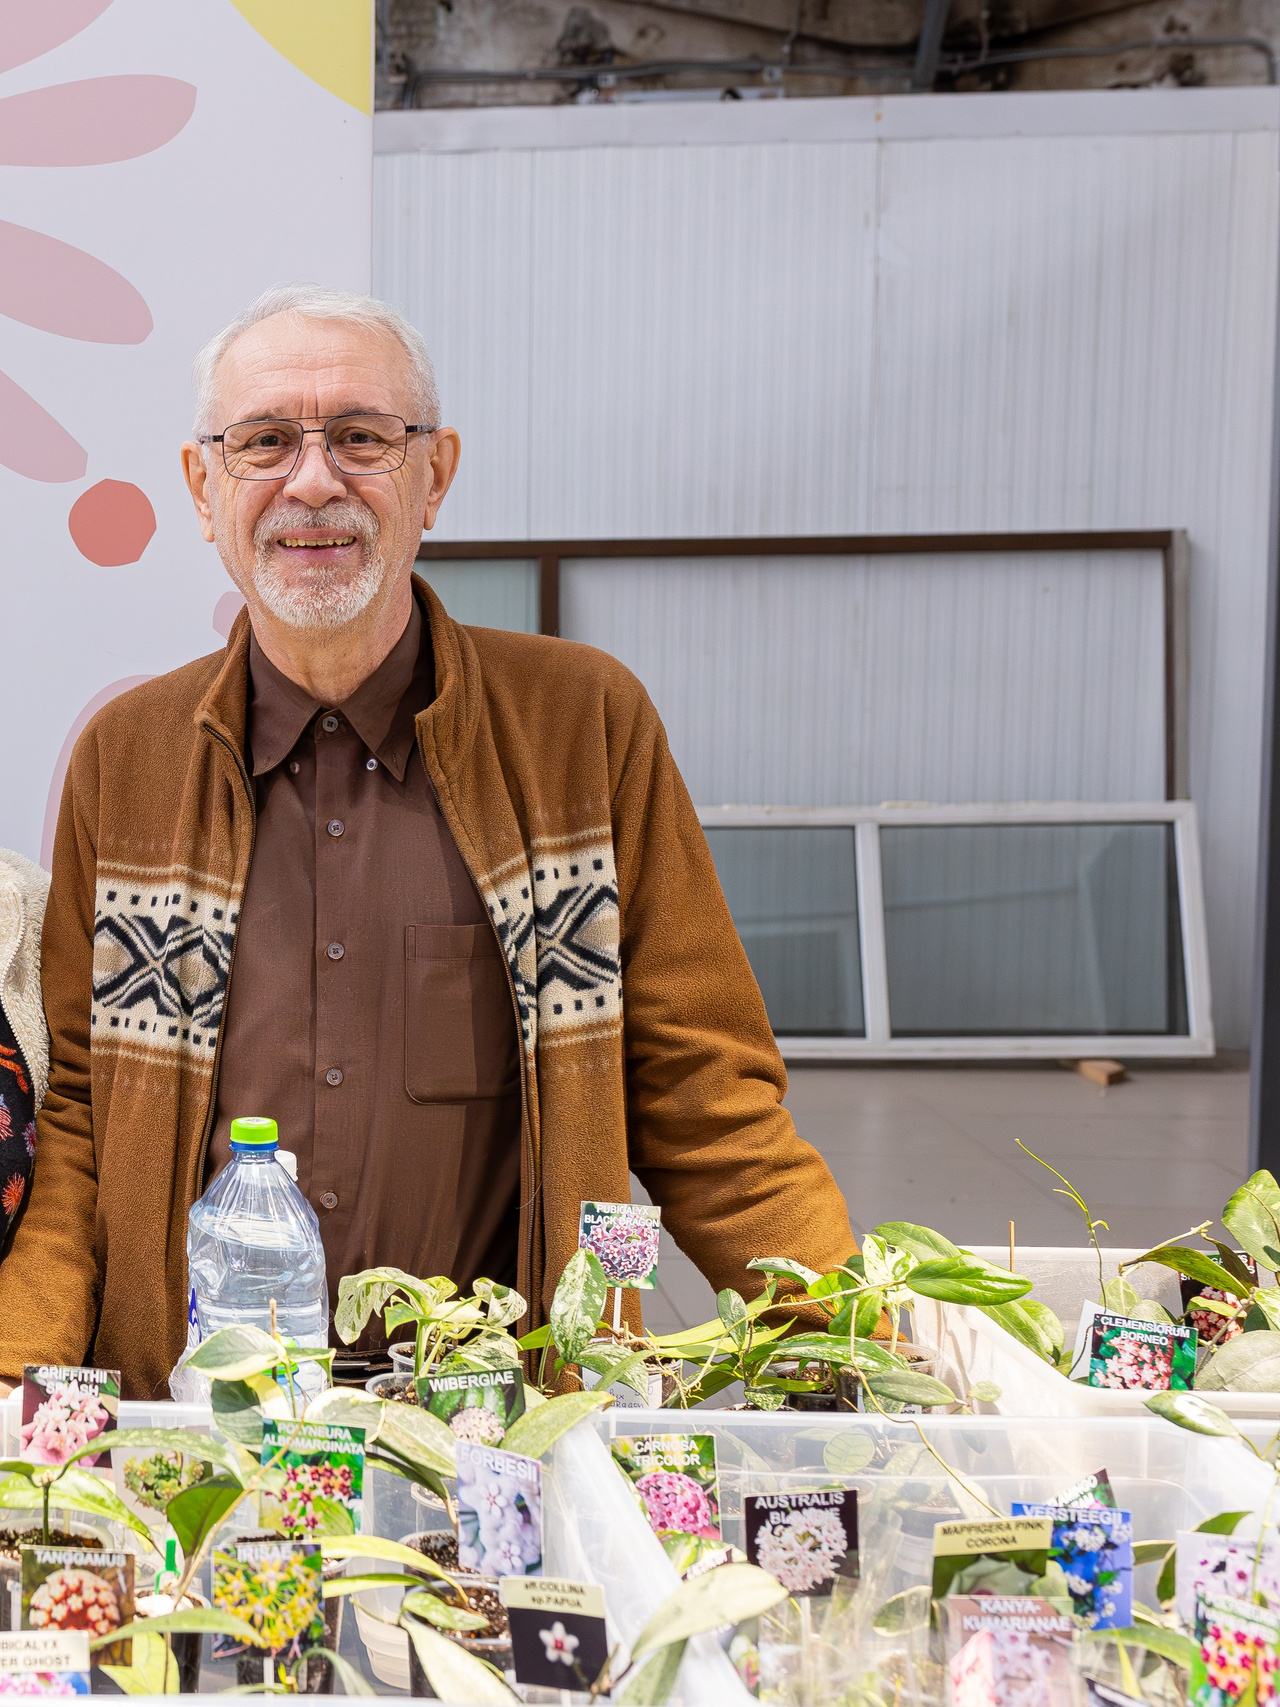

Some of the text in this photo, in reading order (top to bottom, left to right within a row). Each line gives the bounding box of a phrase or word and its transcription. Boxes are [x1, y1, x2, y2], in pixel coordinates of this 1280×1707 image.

[596, 1204, 650, 1216] PUBICALYX
[583, 1214, 660, 1228] BLACK DRAGON
[1100, 1316, 1191, 1339] CLEMENSIORUM
[1121, 1330, 1168, 1346] BORNEO
[38, 1366, 108, 1384] GRIFFITHII
[429, 1370, 515, 1393] WIBERGIAE
[277, 1422, 352, 1440] POLYNEURA
[634, 1440, 699, 1453] CARNOSA
[460, 1447, 538, 1483] FORBESII
[634, 1453, 701, 1467] TRICOLOR
[755, 1492, 845, 1510] AUSTRALIS
[1022, 1505, 1123, 1526] VERSTEEGII
[941, 1520, 1046, 1536] MAPPIGERA PINK
[965, 1535, 1018, 1549] CORONA
[34, 1550, 127, 1568] TANGGAMUS
[979, 1600, 1042, 1614] KANYA-
[963, 1615, 1071, 1632] KUMARIANAE
[23, 1655, 71, 1668] GHOST
